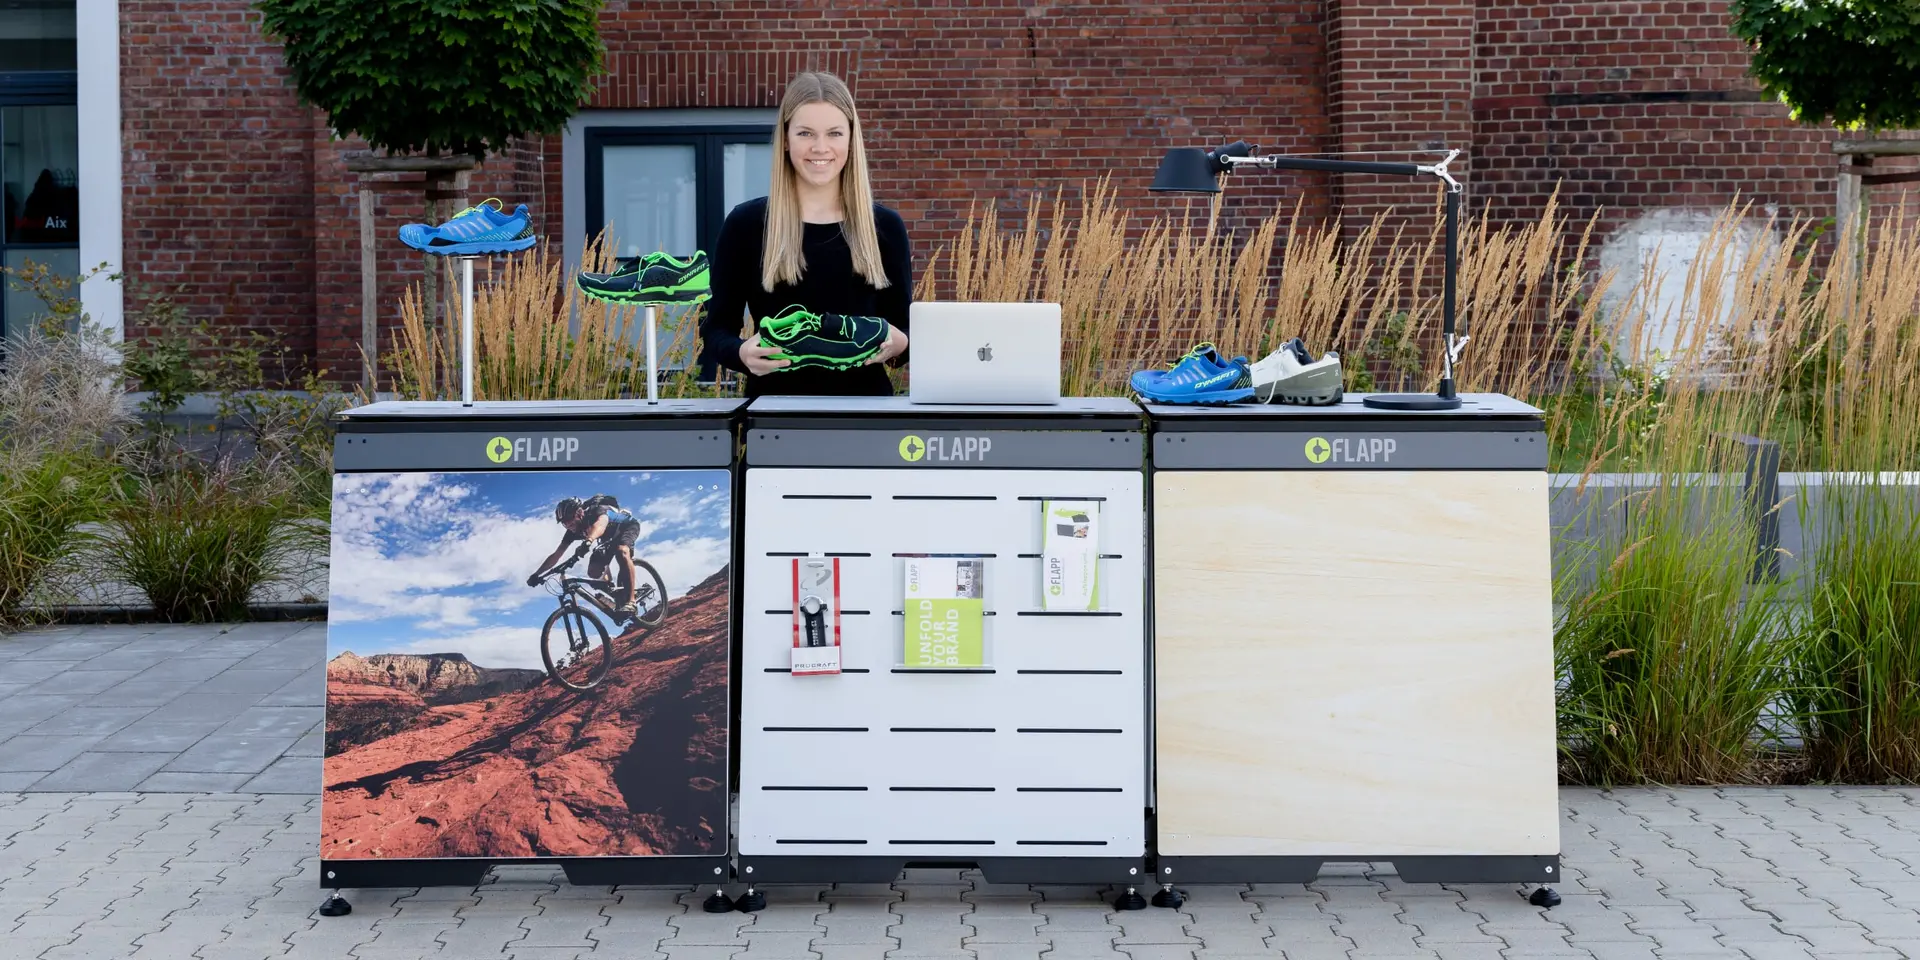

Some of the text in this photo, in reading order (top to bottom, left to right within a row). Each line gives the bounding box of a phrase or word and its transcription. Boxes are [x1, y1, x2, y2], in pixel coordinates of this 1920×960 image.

[678, 262, 706, 284] DYNAFIT
[1194, 369, 1237, 389] DYNAFIT
[514, 437, 579, 462] FLAPP
[926, 437, 992, 461] FLAPP
[1332, 438, 1397, 463] FLAPP
[910, 564, 918, 584] FLAPP
[1050, 557, 1061, 585] FLAPP
[920, 599, 932, 665] UNFOLD
[933, 621, 945, 665] YOUR
[947, 608, 958, 665] BRAND
